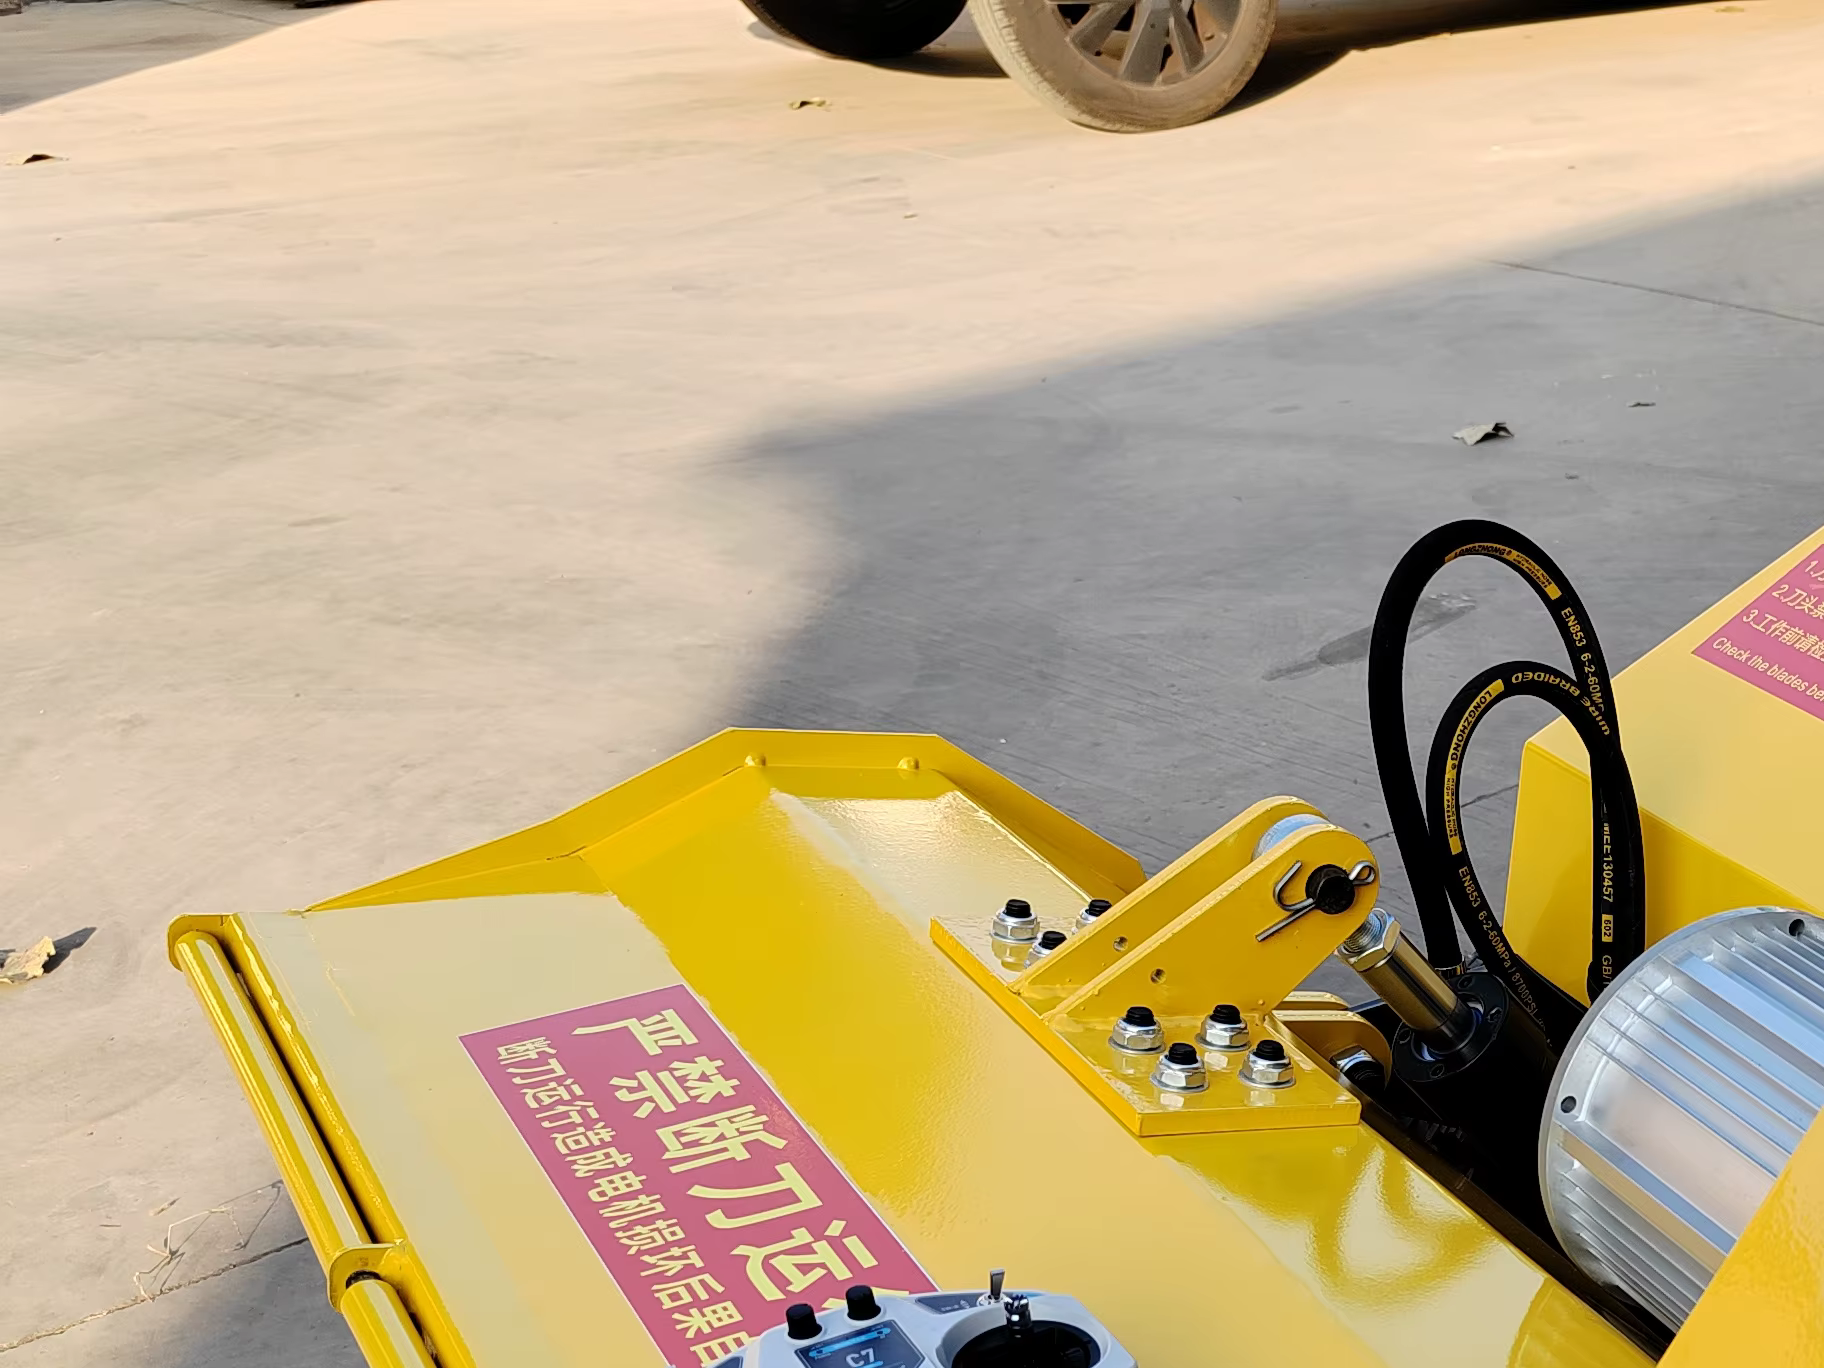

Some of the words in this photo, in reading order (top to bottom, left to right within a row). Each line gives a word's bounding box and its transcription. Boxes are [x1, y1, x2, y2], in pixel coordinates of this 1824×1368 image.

[1561, 607, 1586, 647] EN853
[1511, 671, 1581, 697] BRAIDED
[1712, 637, 1751, 662] Check
[1748, 655, 1769, 673] the
[1767, 663, 1808, 693] blades
[1458, 866, 1481, 908] EN853
[1478, 911, 1512, 968] 6-2-60MPa
[571, 1008, 910, 1309] 严禁断刀运
[845, 1347, 875, 1368] C7
